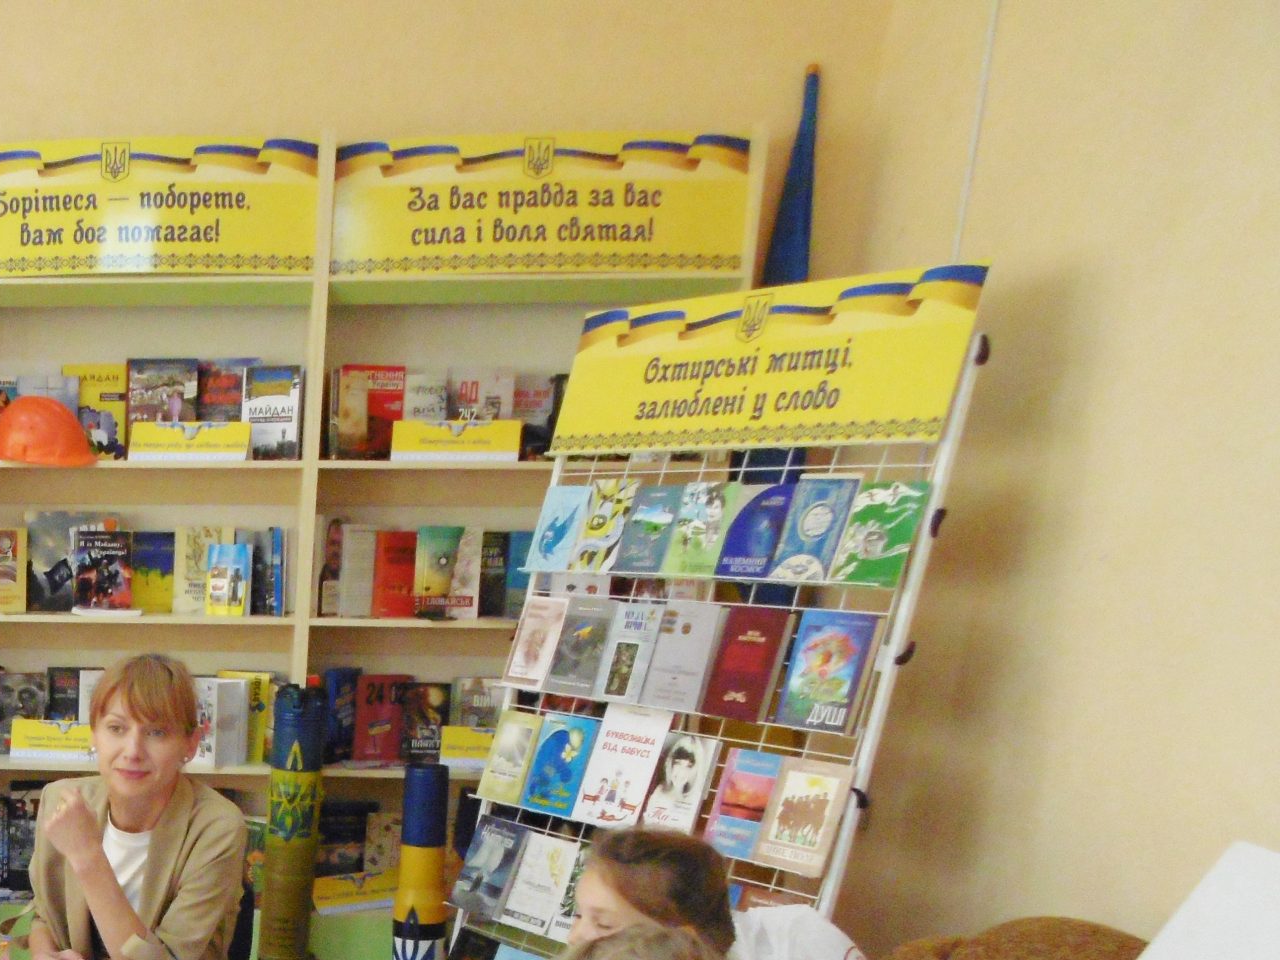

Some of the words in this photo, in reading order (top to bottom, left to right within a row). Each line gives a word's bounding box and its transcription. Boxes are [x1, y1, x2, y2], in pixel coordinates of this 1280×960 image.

[406, 186, 440, 213] За
[497, 182, 579, 214] правда
[587, 186, 616, 208] за
[72, 218, 108, 245] бог
[117, 217, 221, 244] помагає!
[410, 221, 466, 246] сила
[475, 217, 484, 244] і
[492, 217, 548, 243] воля
[556, 216, 655, 243] святая!
[642, 345, 761, 389] Охтирські
[248, 405, 294, 417] МАЙДАН
[633, 387, 746, 422] залюблені
[749, 391, 765, 423] у
[774, 379, 841, 412] слово
